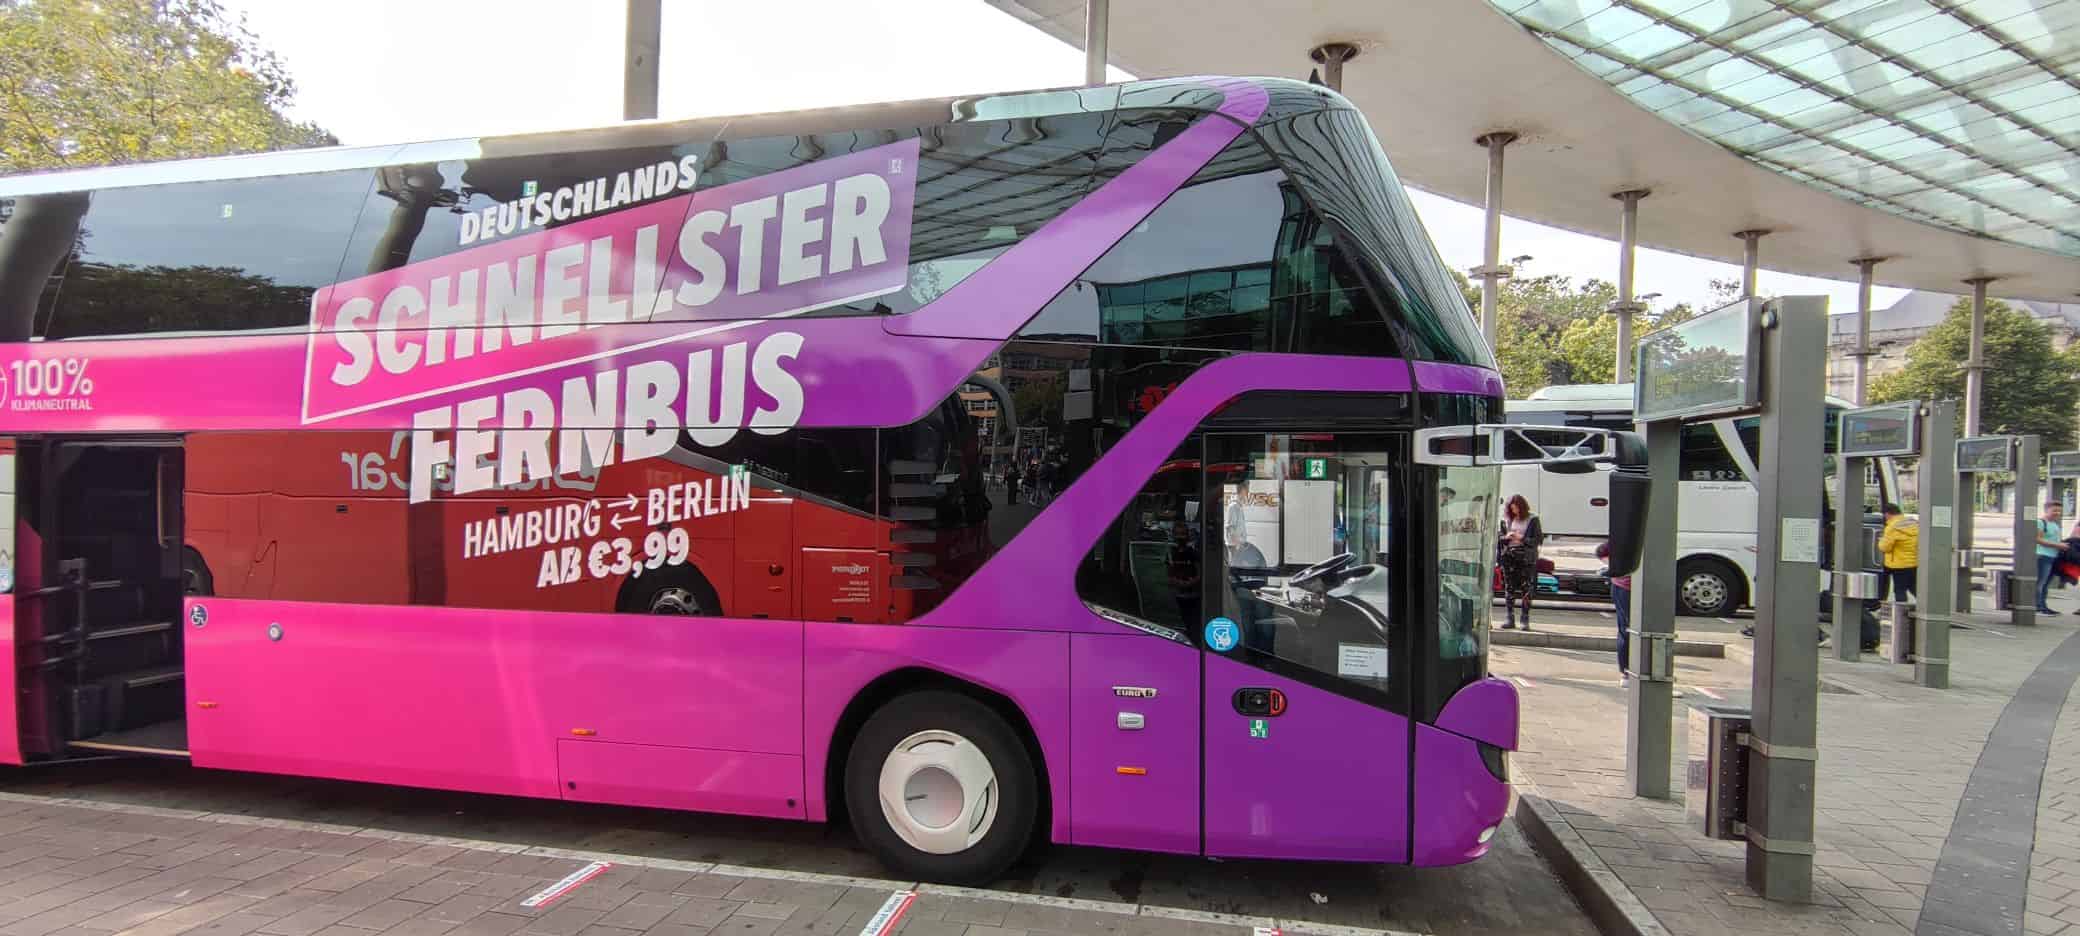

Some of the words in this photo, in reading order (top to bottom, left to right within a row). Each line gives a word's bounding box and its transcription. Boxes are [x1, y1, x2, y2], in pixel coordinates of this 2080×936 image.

[459, 154, 697, 246] DEUTSCHLANDS
[330, 172, 891, 386] SCHNELLSTER
[11, 358, 93, 396] 100%
[11, 399, 94, 411] KLIMANEUTRAL
[410, 332, 804, 504] FERNBUS
[463, 499, 601, 559] HAMBURG
[646, 470, 750, 526] BERLIN
[536, 547, 582, 588] AB
[588, 527, 689, 579] €3,99
